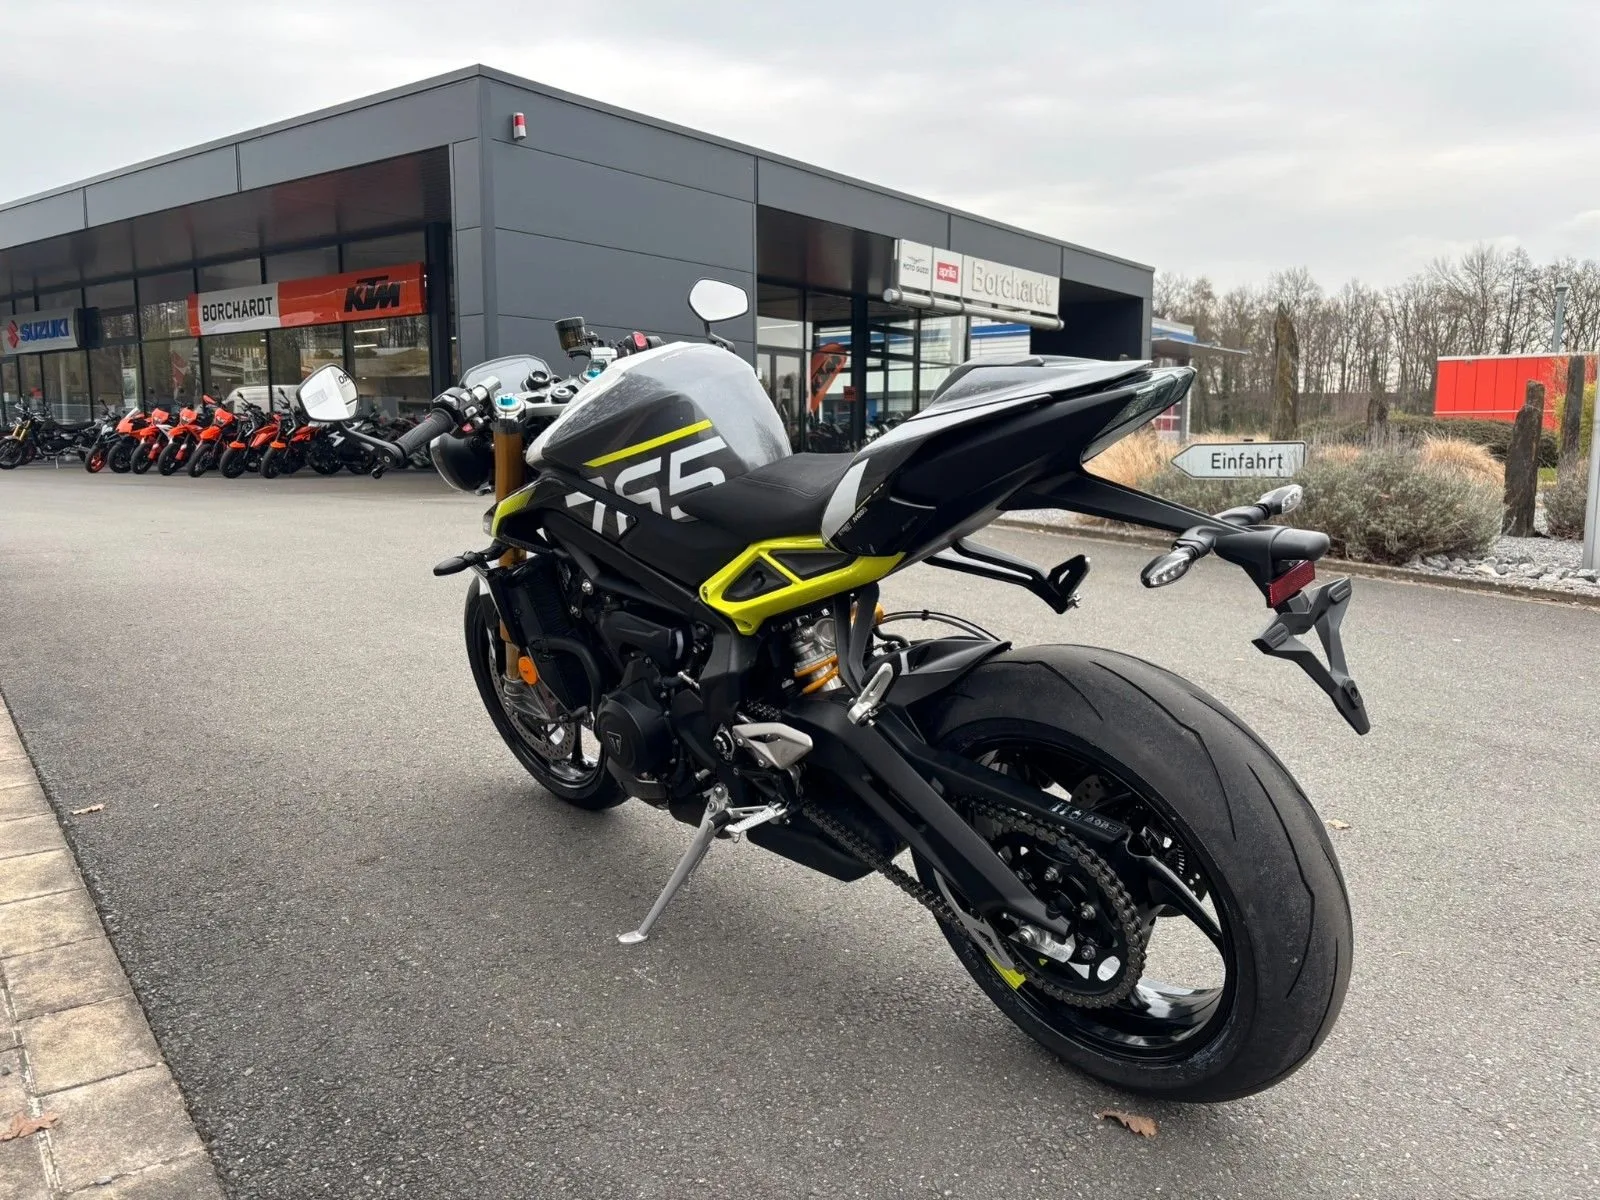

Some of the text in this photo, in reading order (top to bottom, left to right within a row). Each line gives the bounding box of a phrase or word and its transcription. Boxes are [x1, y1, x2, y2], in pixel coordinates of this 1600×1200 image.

[938, 265, 958, 281] aprilia
[971, 260, 1052, 306] Borchardt
[343, 275, 400, 312] KTM
[202, 296, 273, 322] BORCHARDT
[20, 318, 70, 342] SUZUKI
[1211, 452, 1283, 470] Einfahrt
